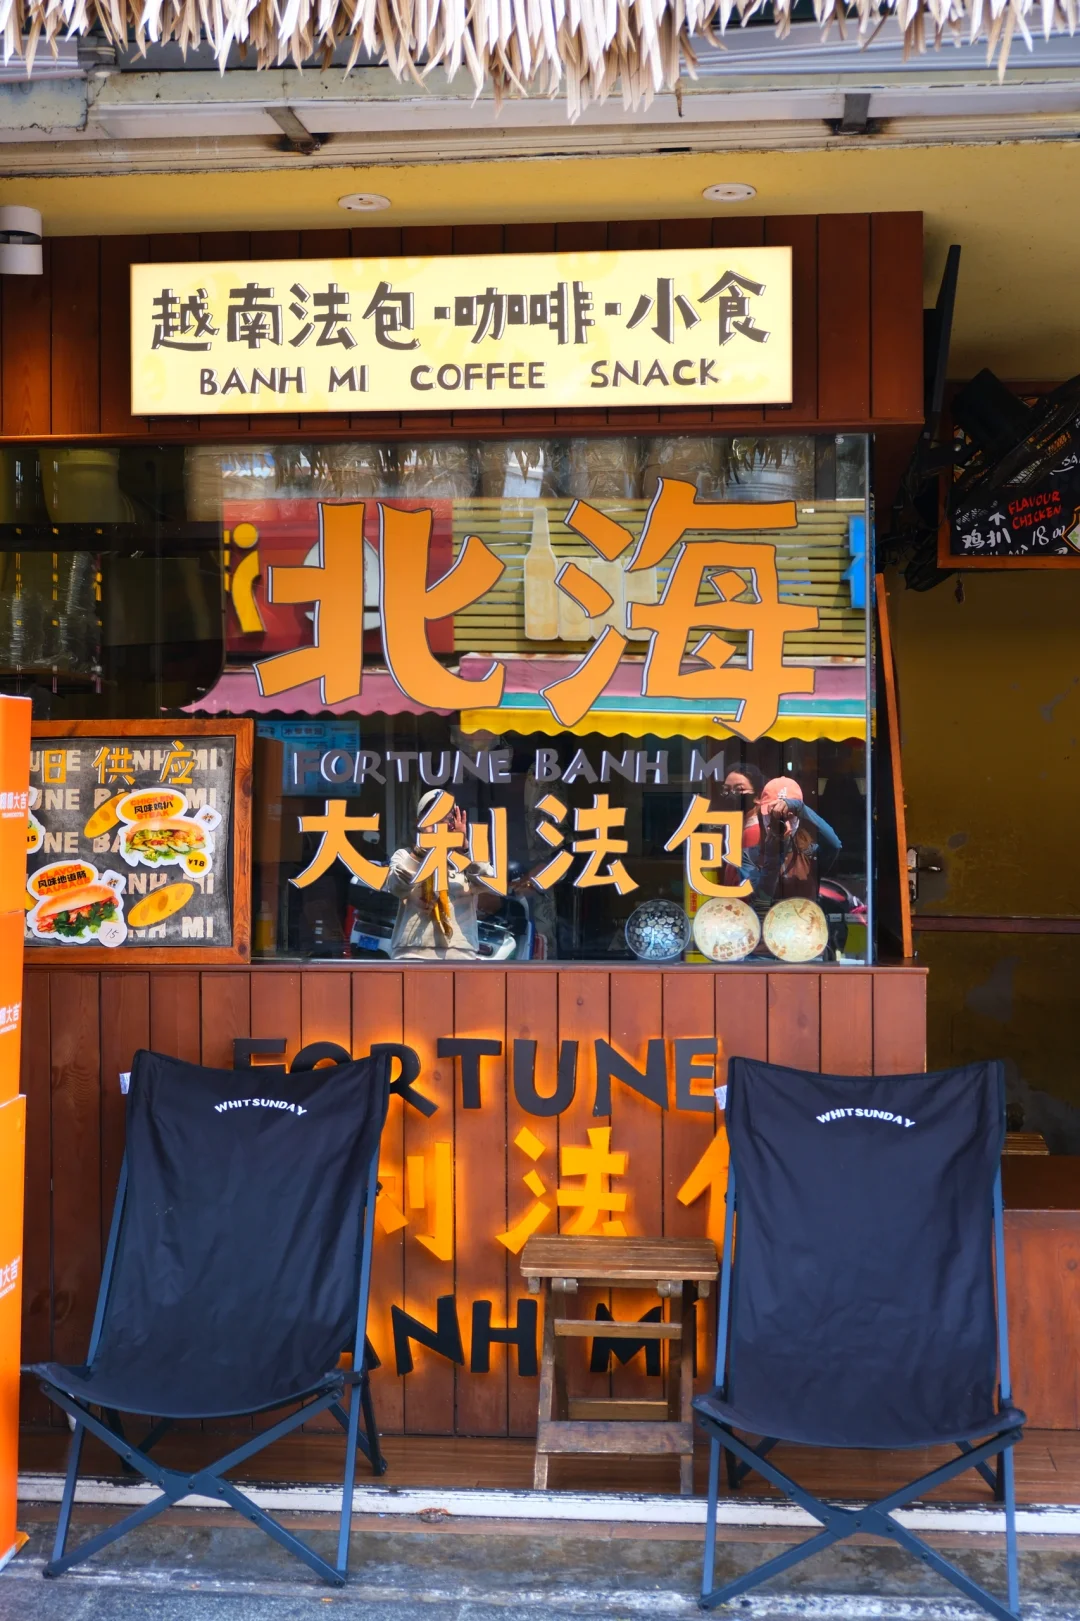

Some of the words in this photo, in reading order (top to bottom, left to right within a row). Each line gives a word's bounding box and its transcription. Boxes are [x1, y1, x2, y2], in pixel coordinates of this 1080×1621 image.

[199, 366, 306, 396] BANH
[328, 363, 370, 394] MI
[410, 360, 547, 392] COFFEE
[590, 356, 720, 389] SNACK
[1008, 490, 1061, 514] FLAVOUR
[1012, 506, 1062, 530] CHICKEN
[961, 527, 1012, 549] 鸡扒
[253, 476, 820, 742] 北海
[293, 748, 512, 787] FORTUNE
[535, 748, 668, 785] BANH
[288, 791, 753, 898] 大利法包
[182, 917, 214, 938] MI
[214, 1098, 307, 1116] WHITSUNDAY
[816, 1108, 915, 1127] WHITSUNDAY
[0, 1256, 20, 1289] 大吉
